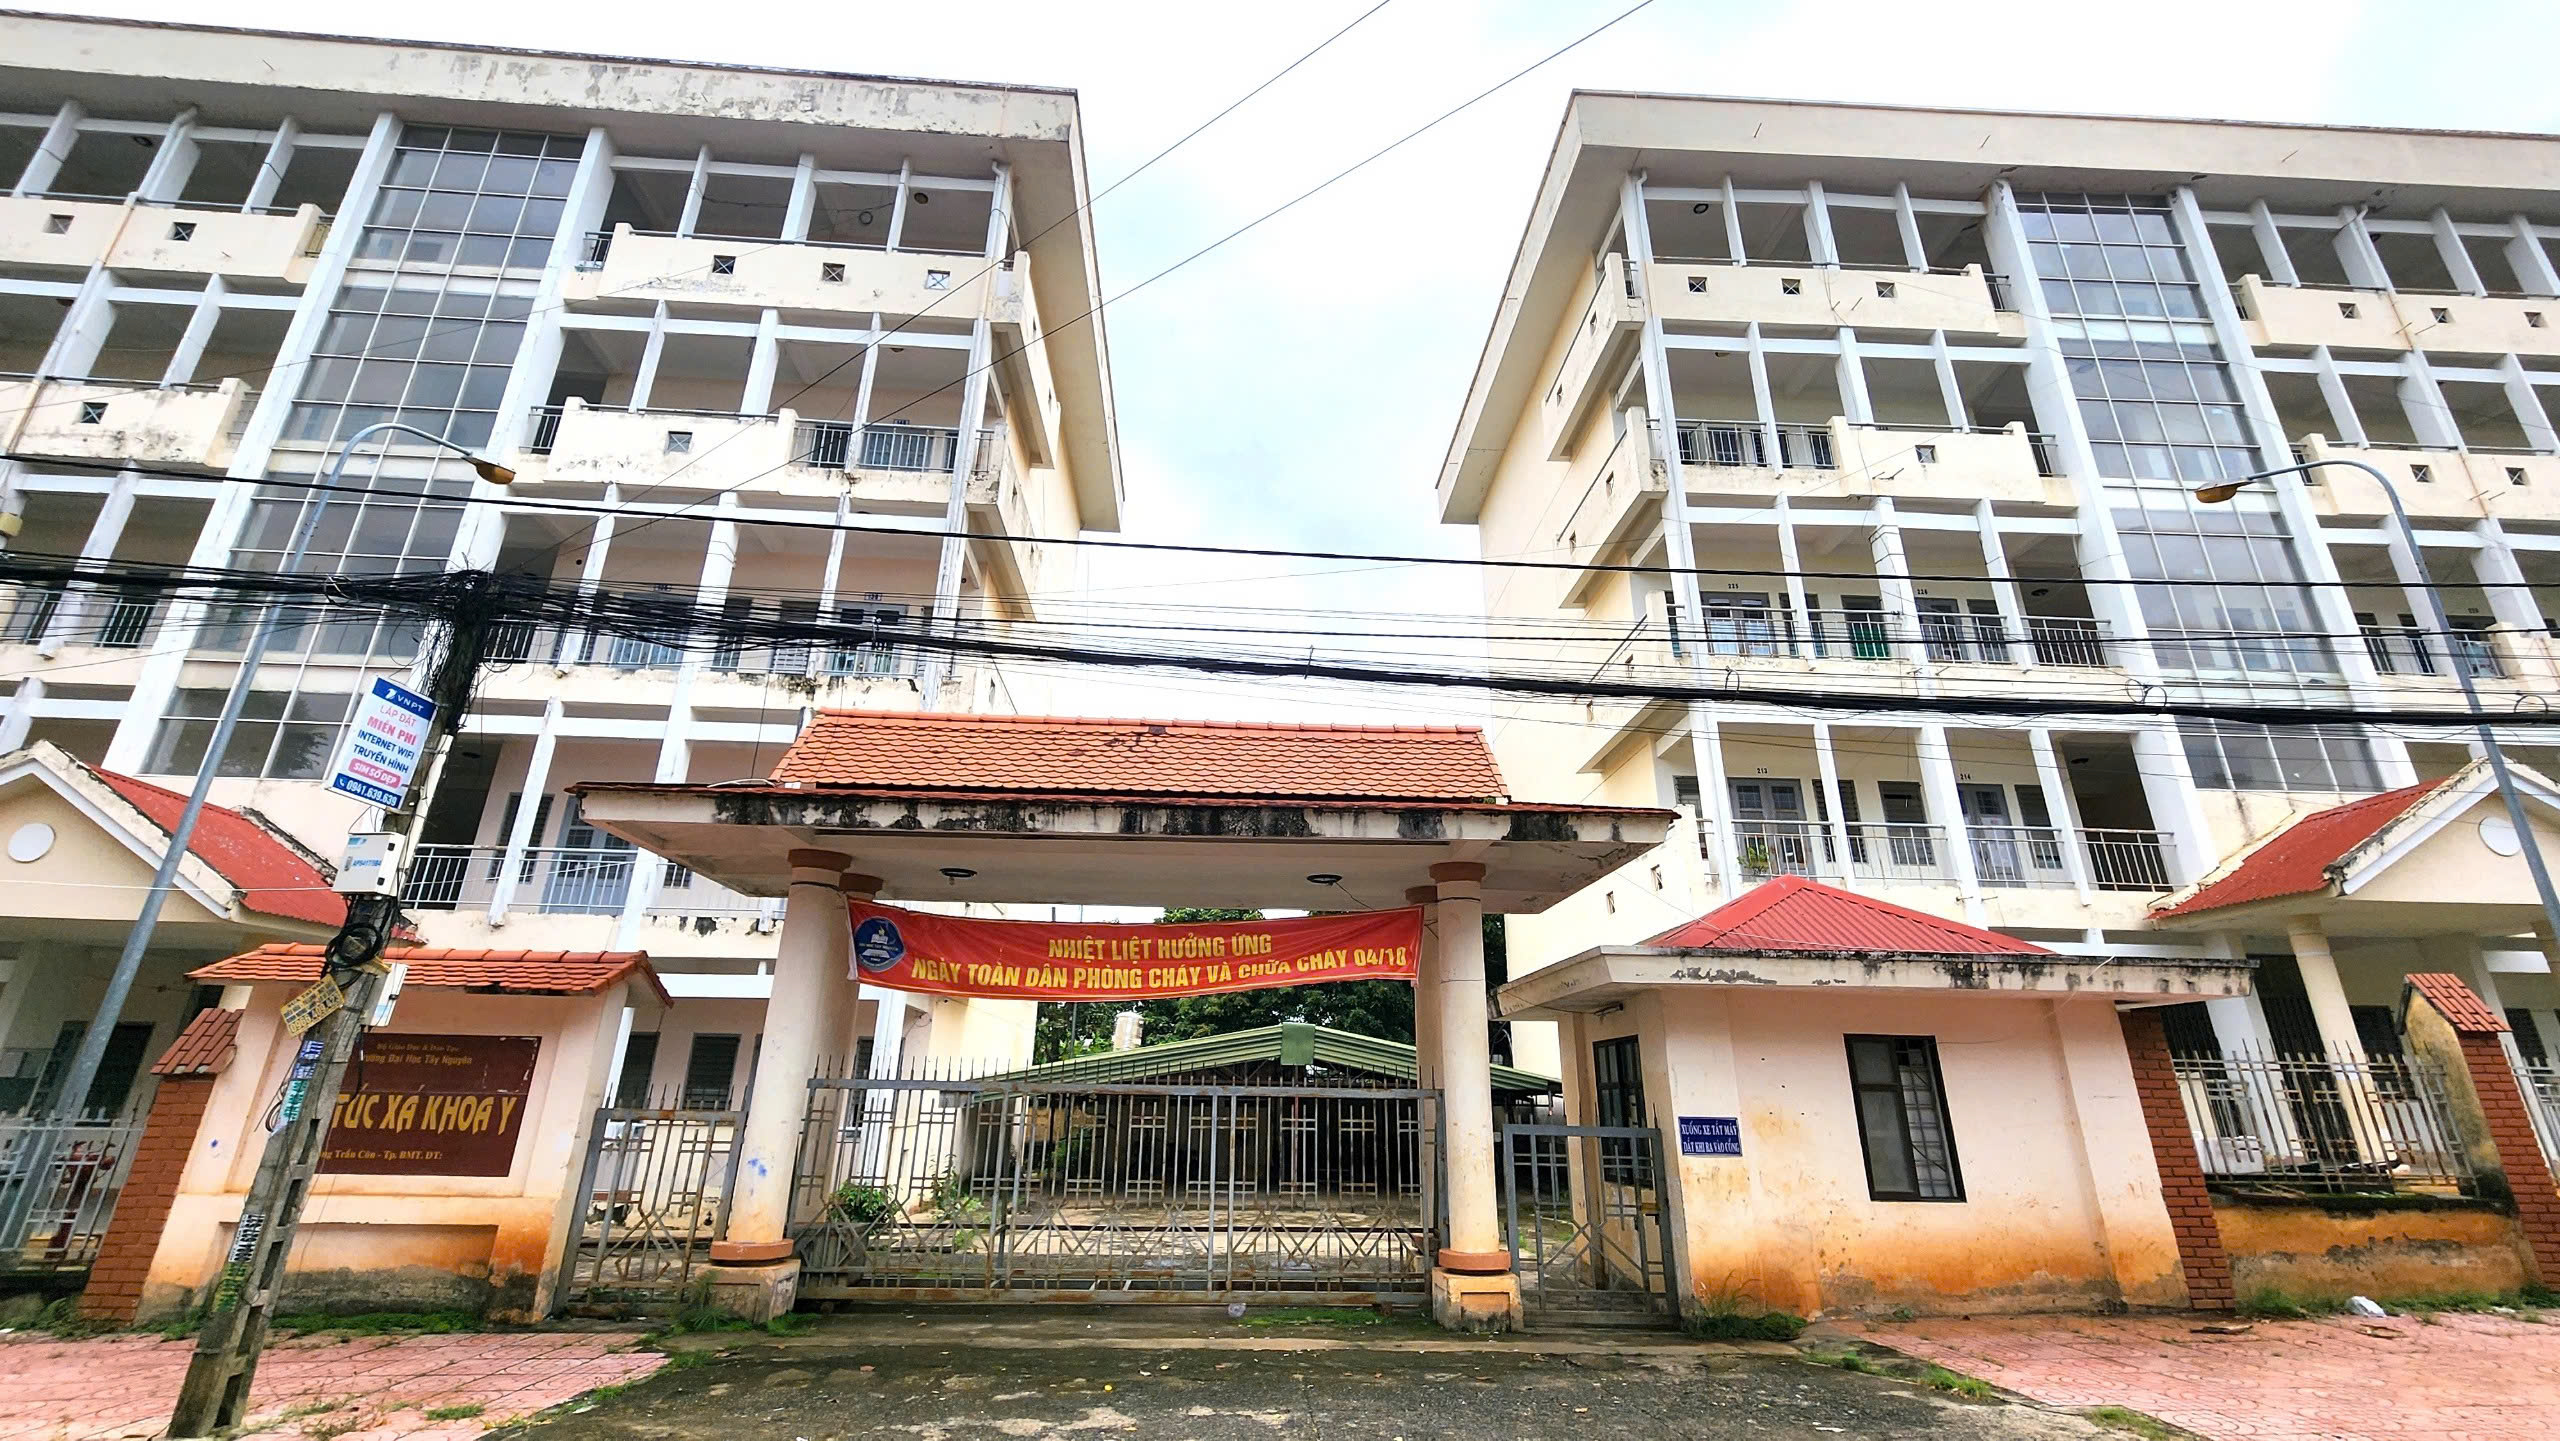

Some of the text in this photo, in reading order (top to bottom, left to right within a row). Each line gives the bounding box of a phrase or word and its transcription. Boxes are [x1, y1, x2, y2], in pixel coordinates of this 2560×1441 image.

[398, 693, 425, 713] VNPT
[357, 729, 415, 761] INTERNET WIFI
[396, 730, 417, 746] PHÍ
[353, 761, 398, 786] SIM SỐ ĐẸP
[387, 757, 409, 774] HÌNH
[346, 779, 398, 806] 0941.639.639
[1048, 931, 1273, 965] NHIỆT LIỆT HƯỞNG ỨNG
[911, 956, 962, 984] NGÀY
[967, 961, 1021, 987] TOÀN
[1024, 963, 1068, 988] DÂN
[1072, 964, 1143, 990] PHÒNG
[1149, 962, 1201, 989] CHÁY
[1206, 961, 1232, 984] VÀ
[1238, 959, 1291, 979] CHỮA
[1296, 948, 1348, 973] CHÁY
[379, 1084, 425, 1133] XÁ
[421, 1095, 494, 1135] KHOA
[497, 1096, 518, 1135] Y
[1681, 1120, 1738, 1136] XUỐNG XE TẮT MÁY
[399, 1150, 424, 1160] BMT.
[1695, 1141, 1706, 1153] KHI
[1705, 1141, 1715, 1153] RA
[1713, 1139, 1725, 1153] VÀO
